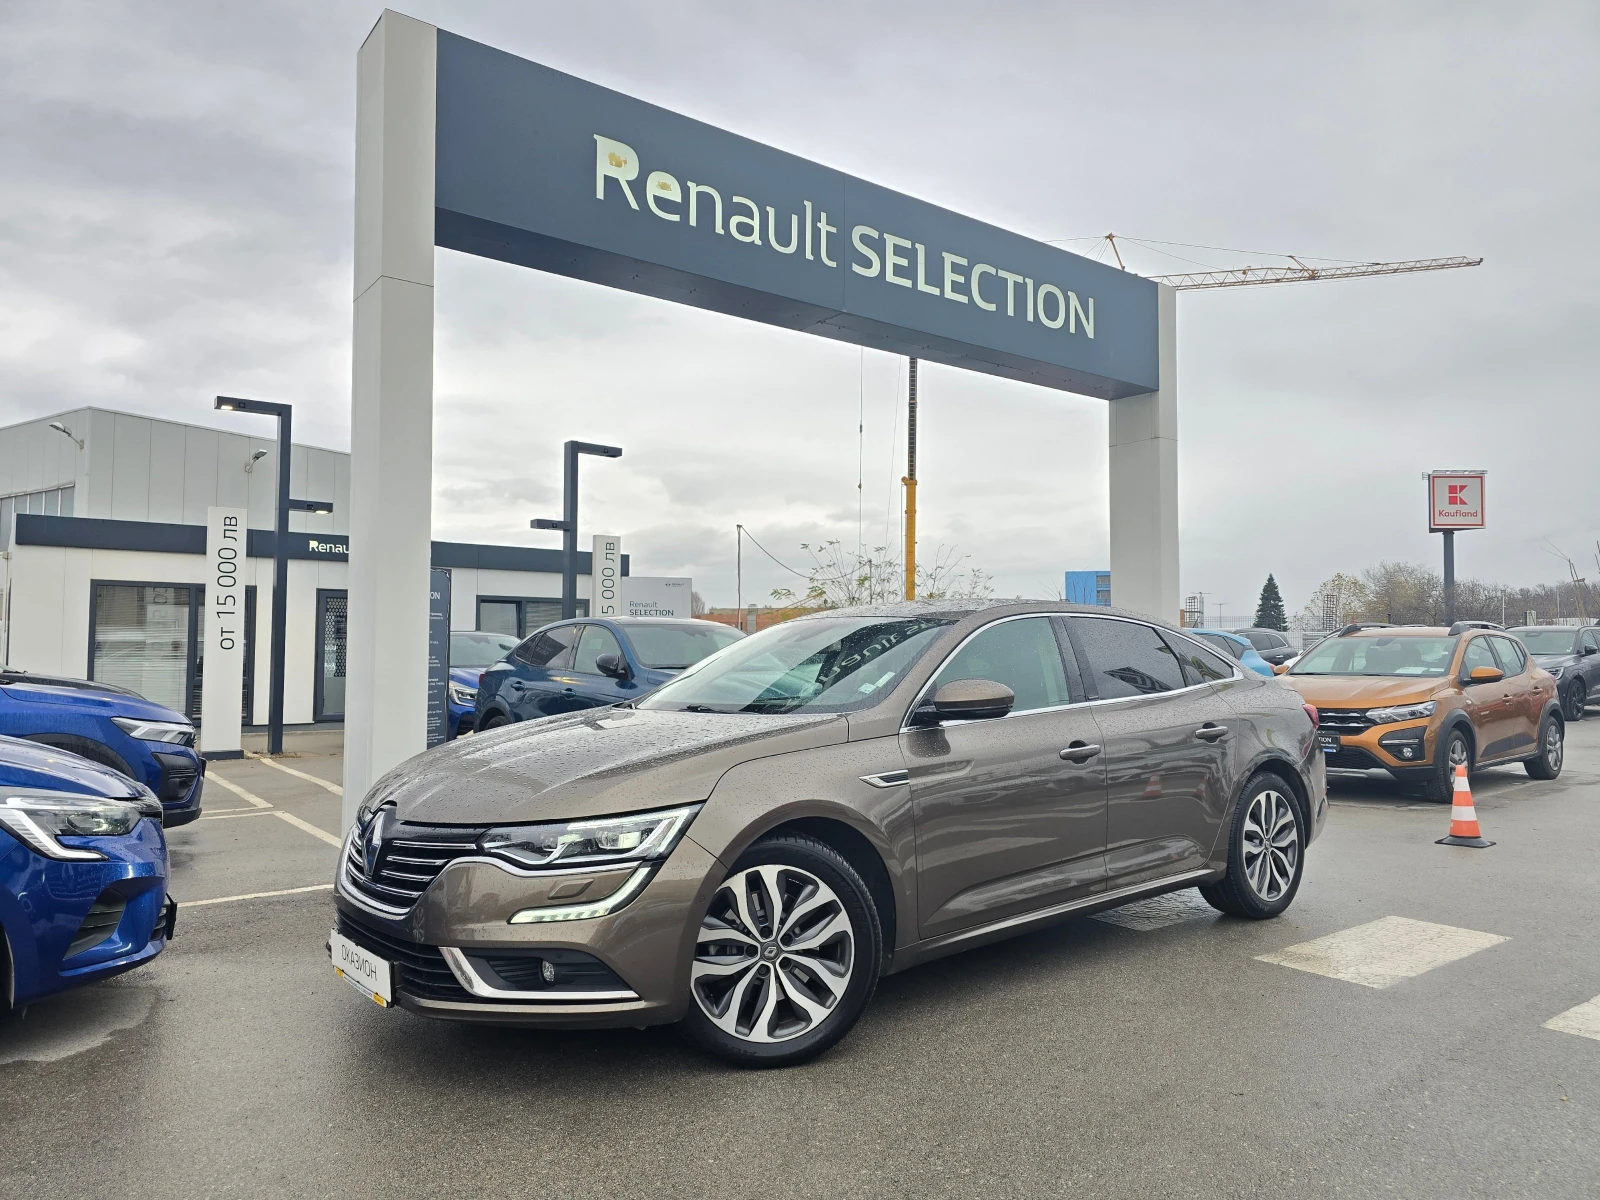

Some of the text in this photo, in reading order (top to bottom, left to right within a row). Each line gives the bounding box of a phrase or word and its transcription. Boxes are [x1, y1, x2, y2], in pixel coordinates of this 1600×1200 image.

[593, 133, 1095, 339] Renault SELECTION
[308, 540, 349, 554] Renau
[217, 547, 237, 588] 000
[601, 567, 615, 599] 000
[216, 595, 236, 618] 15
[601, 605, 615, 614] 5
[341, 944, 378, 981] ОКАЗИОН
